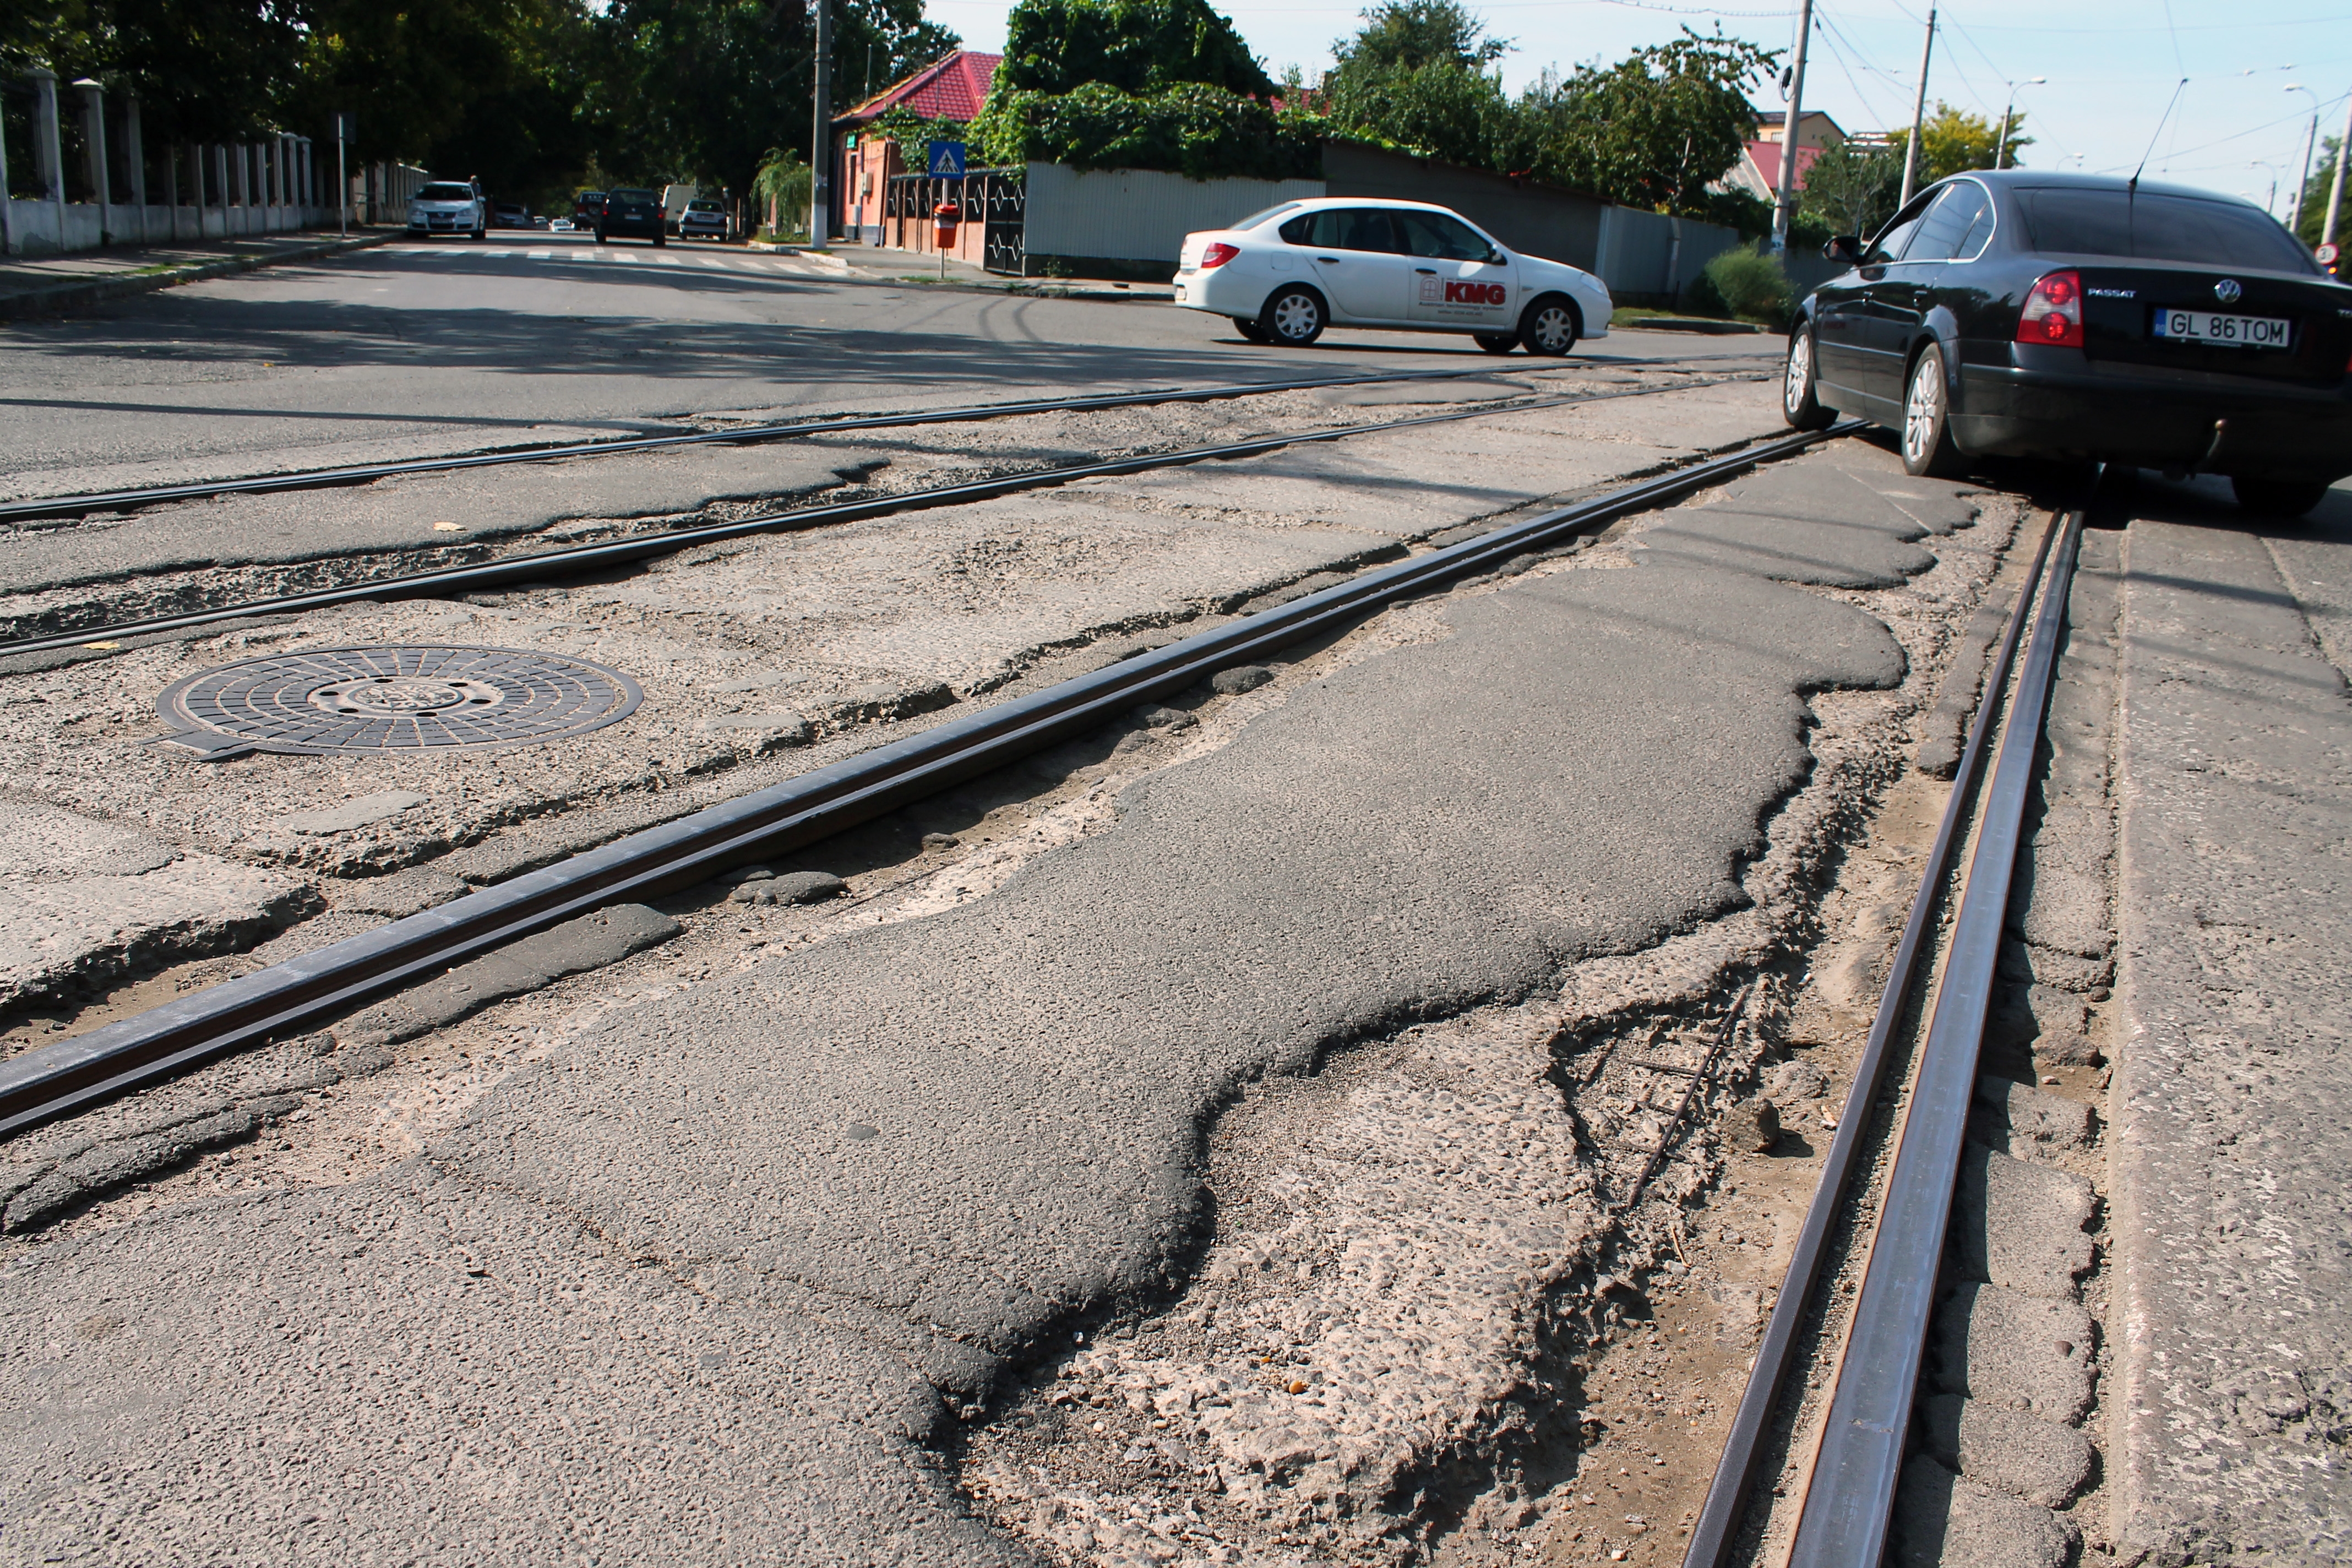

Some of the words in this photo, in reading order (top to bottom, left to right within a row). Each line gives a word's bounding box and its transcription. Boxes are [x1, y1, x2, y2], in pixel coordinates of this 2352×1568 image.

[1445, 281, 1506, 305] KMG
[2087, 288, 2136, 298] PASSAT
[2171, 313, 2200, 336] GL
[2209, 316, 2236, 339] 86
[2241, 319, 2284, 344] TOM
